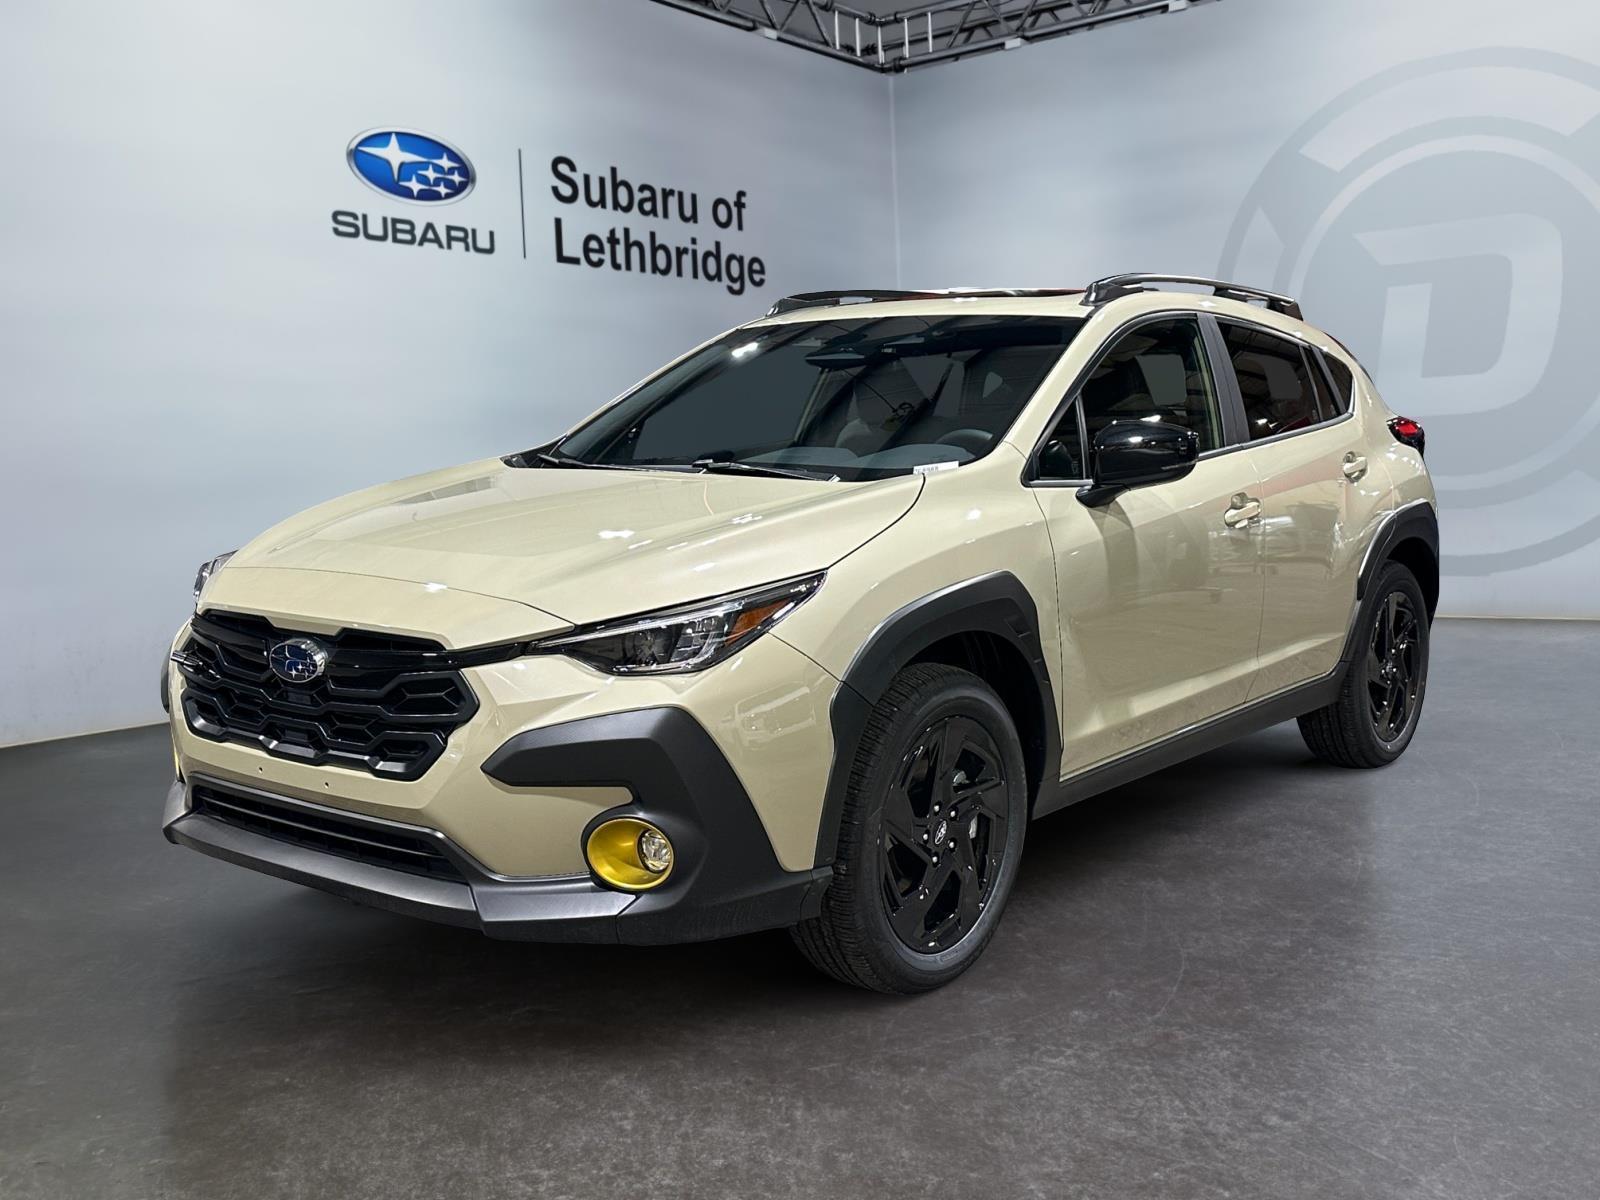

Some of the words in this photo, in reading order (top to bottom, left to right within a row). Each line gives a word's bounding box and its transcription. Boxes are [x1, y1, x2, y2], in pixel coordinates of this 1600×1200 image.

[551, 155, 699, 225] Subaru
[711, 189, 747, 232] of
[331, 210, 496, 255] SUBARU
[554, 217, 767, 296] Lethbridge
